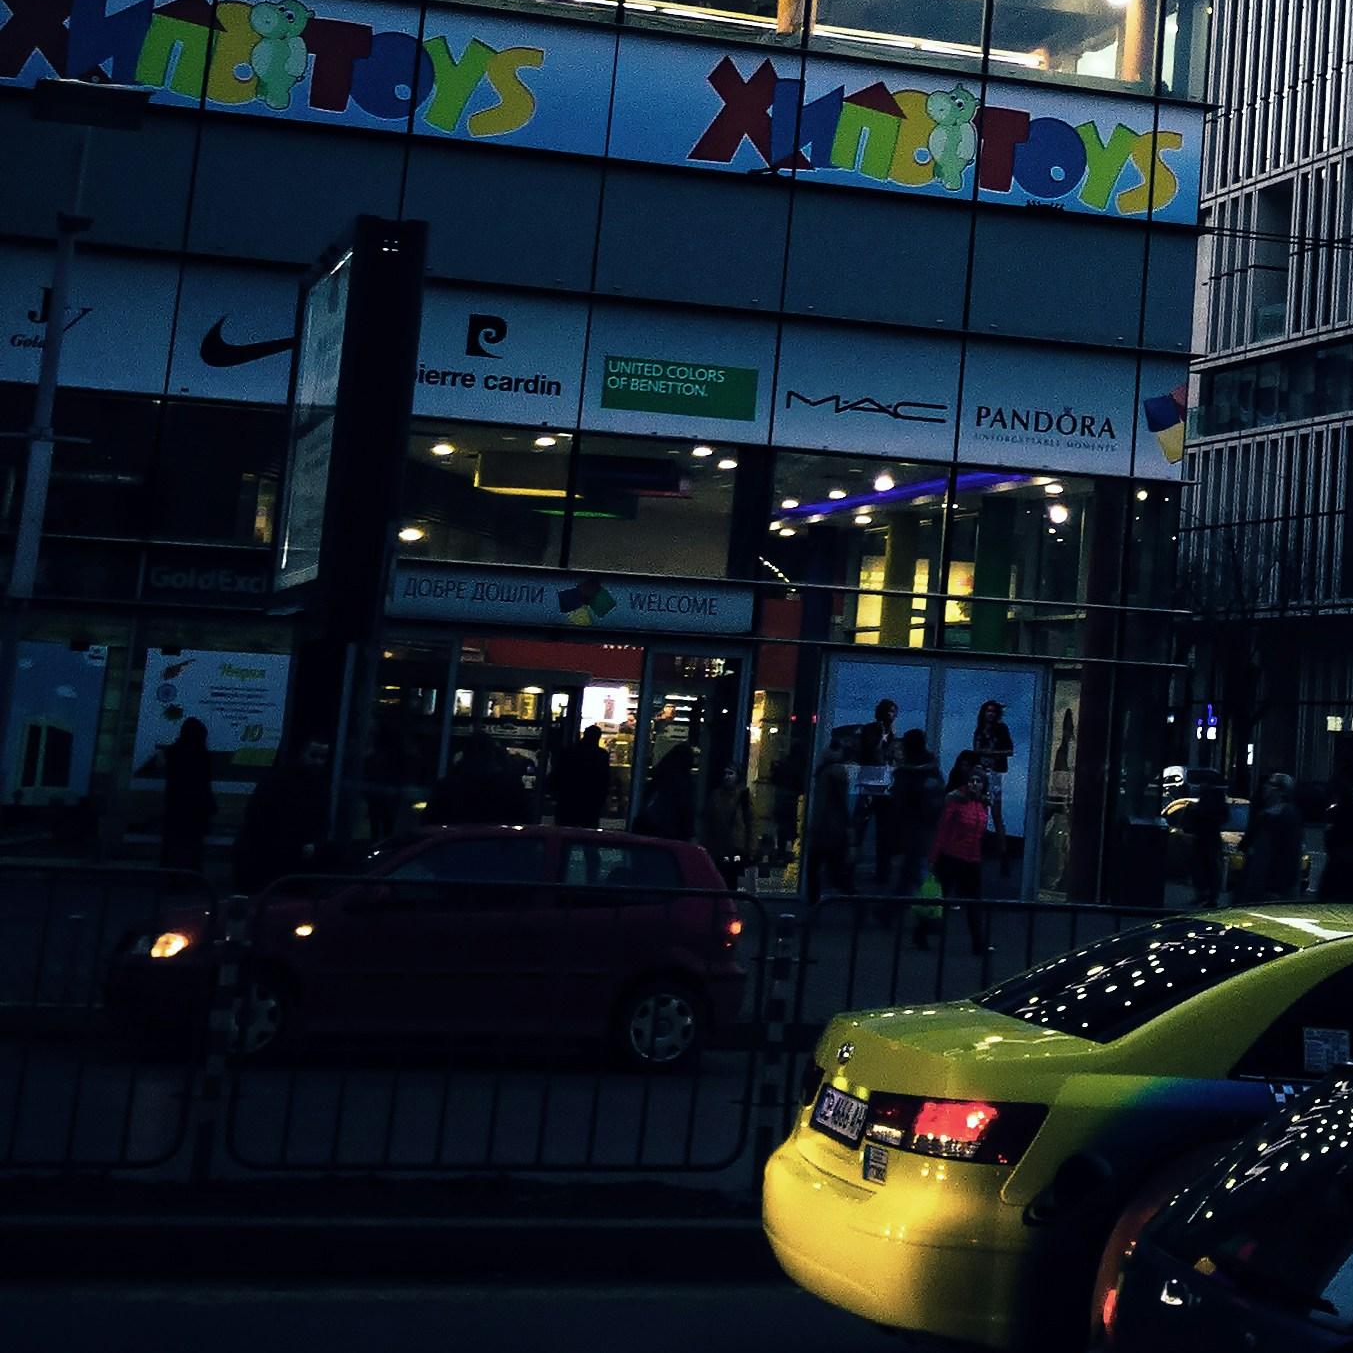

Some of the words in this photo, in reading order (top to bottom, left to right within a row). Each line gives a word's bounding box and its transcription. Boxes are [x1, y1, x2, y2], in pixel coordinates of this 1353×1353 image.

[413, 363, 475, 388] ierre
[484, 373, 561, 396] cardin
[607, 376, 628, 390] OF
[608, 360, 663, 377] UNITED
[666, 366, 726, 383] COLORS
[976, 406, 1115, 440] PANDORA
[404, 577, 466, 601] ДОБРЕ
[471, 581, 544, 604] ДОШЛИ
[629, 592, 717, 616] WELCOME
